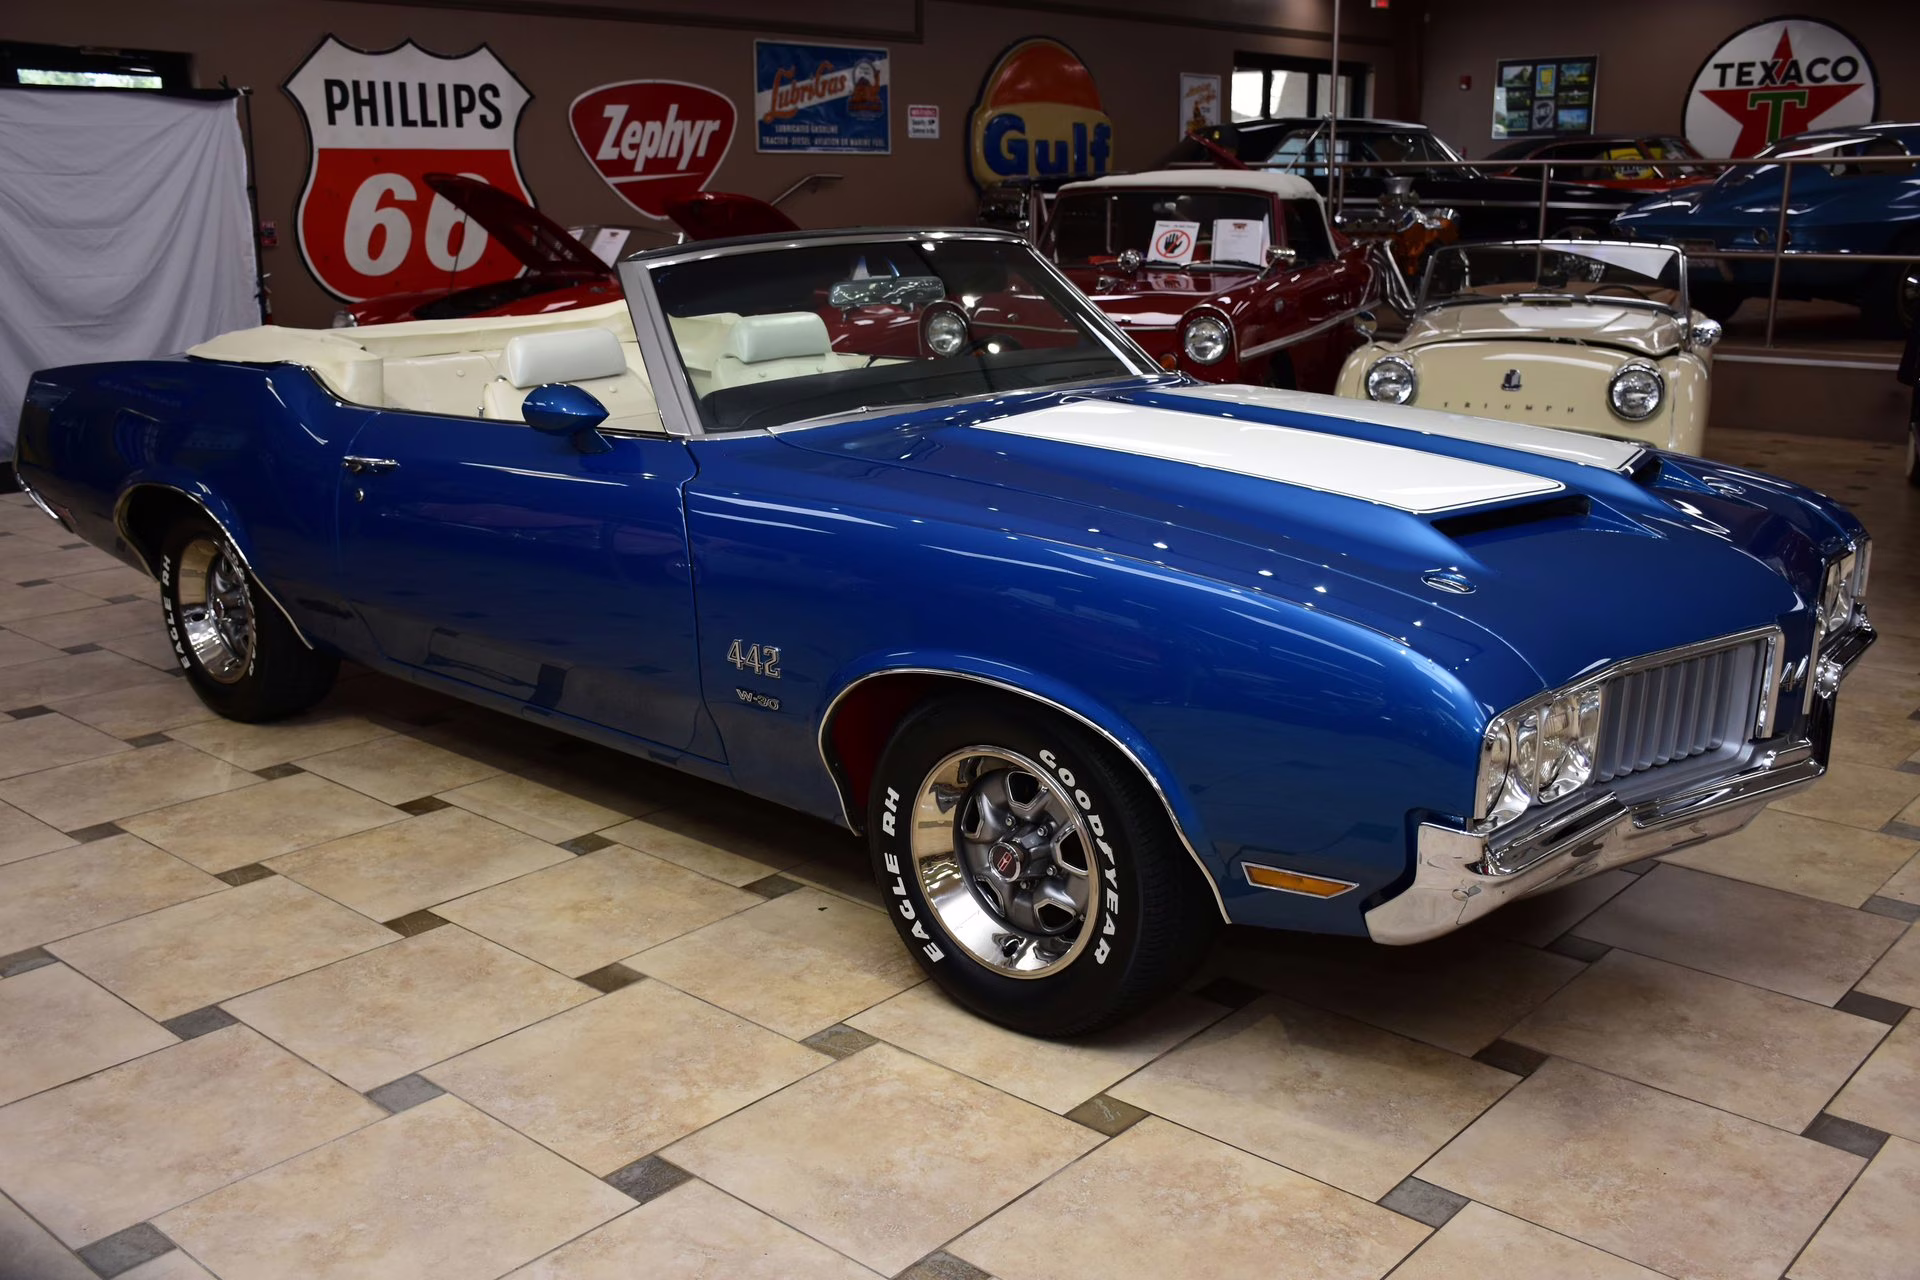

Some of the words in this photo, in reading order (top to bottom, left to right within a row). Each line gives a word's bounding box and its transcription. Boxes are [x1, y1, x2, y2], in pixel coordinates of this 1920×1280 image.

[1713, 56, 1860, 88] TEXACO
[323, 78, 503, 130] PHILLIPS
[1747, 89, 1809, 146] T
[596, 103, 722, 173] Zephyr
[983, 113, 1112, 176] Gulf
[343, 172, 491, 277] 66
[1444, 401, 1575, 414] TRIUMPH
[162, 555, 171, 587] RH
[163, 596, 191, 670] EAGLE
[727, 638, 782, 679] 442
[736, 688, 780, 711] W-30
[1779, 654, 1809, 693] 44
[882, 786, 900, 837] RH
[1039, 749, 1119, 965] GOODYEAR
[884, 852, 945, 964] EAGLE
